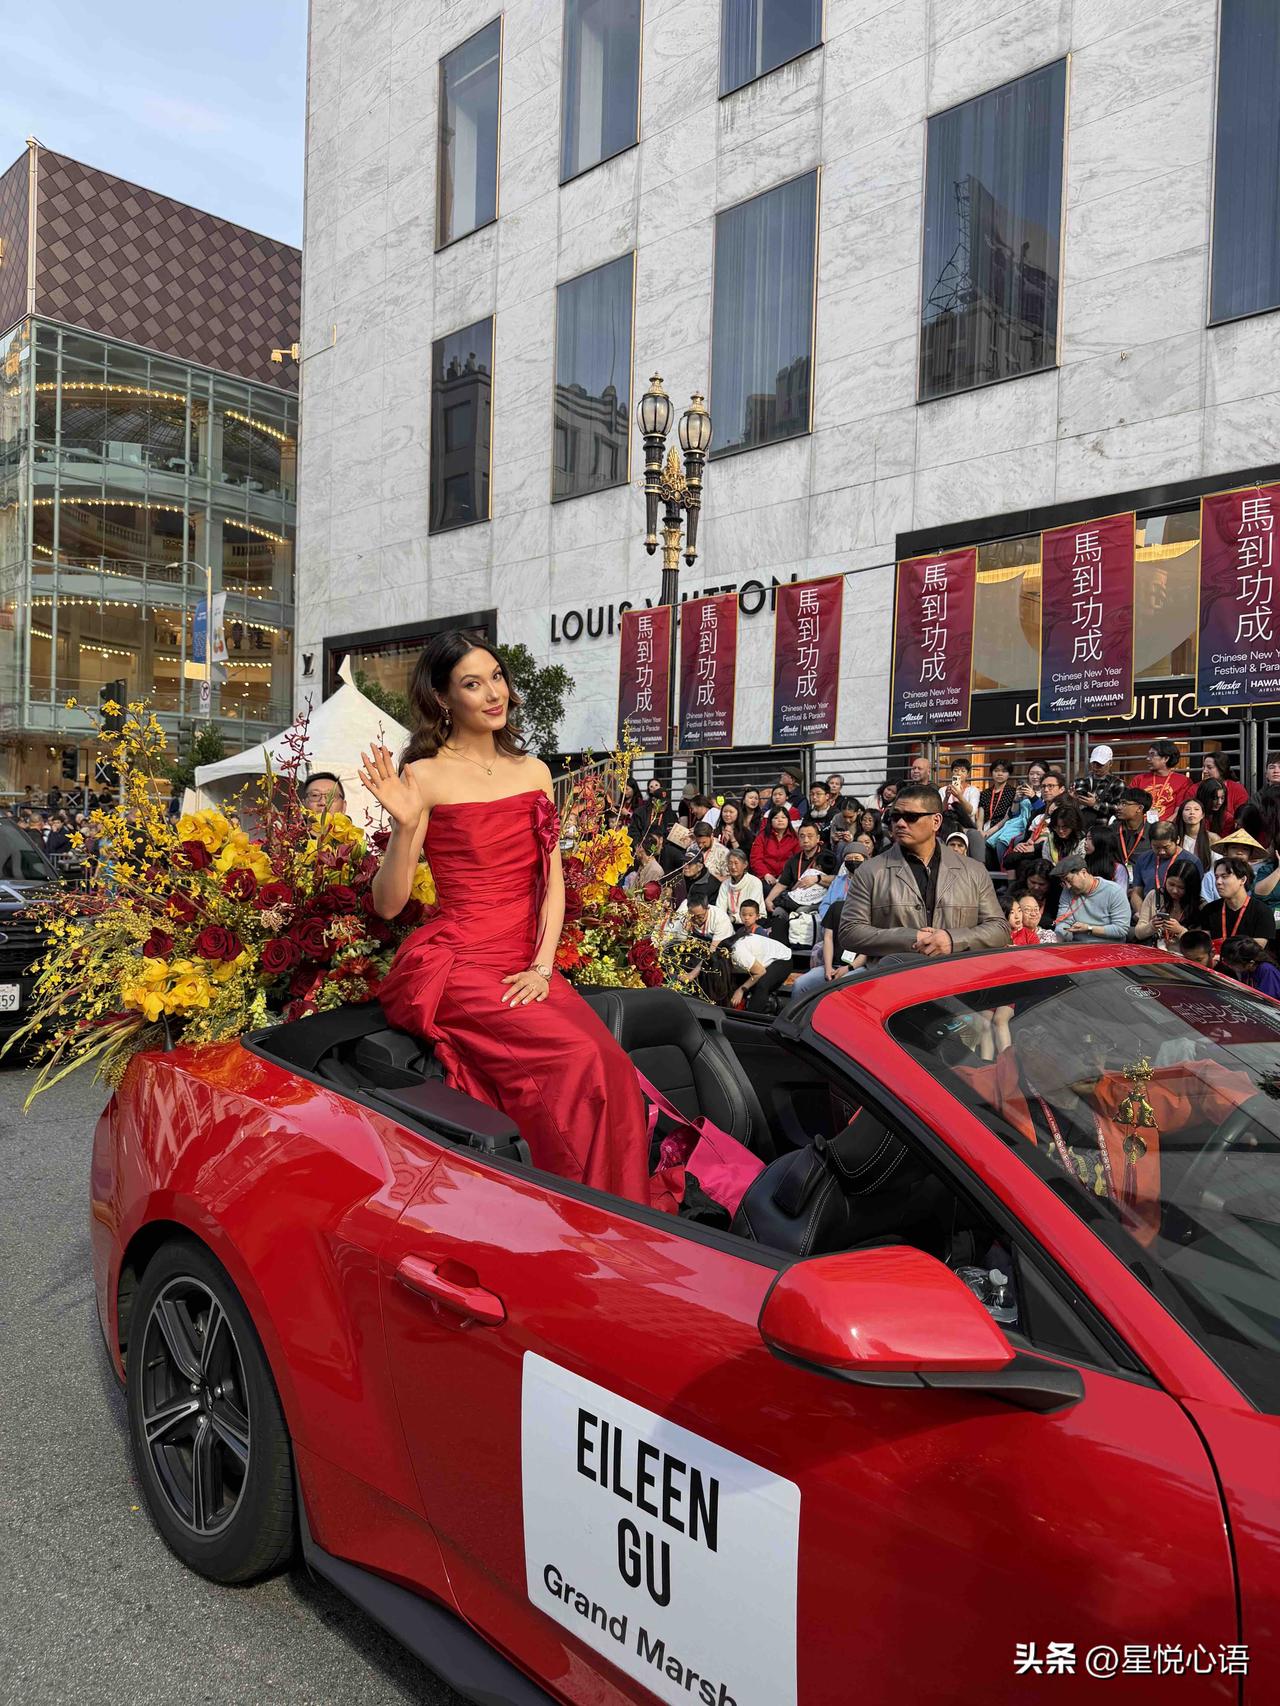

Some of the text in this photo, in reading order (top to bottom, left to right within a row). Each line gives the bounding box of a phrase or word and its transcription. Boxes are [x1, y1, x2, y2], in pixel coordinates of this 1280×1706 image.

[1234, 497, 1274, 643] 馬到功成
[1071, 530, 1103, 664] 馬到功成
[919, 562, 948, 683] 馬到功成
[795, 588, 819, 698] 馬到功成
[696, 603, 718, 706] 馬到功成
[1212, 653, 1248, 664] Chinese
[1251, 651, 1273, 660] New
[635, 615, 653, 712] 馬到功成
[1215, 665, 1247, 676] Festival
[1250, 664, 1257, 673] &
[1052, 667, 1123, 683] Chinese New Year
[903, 687, 961, 699] Chinese New Year
[1055, 679, 1120, 693] Festival & Parade
[1210, 681, 1242, 691] Alaska
[818, 702, 829, 710] Year
[905, 701, 927, 709] Festival
[936, 698, 958, 706] Parade
[1051, 694, 1124, 708] Alaska HAWAIIAN
[783, 714, 802, 722] Festival
[809, 712, 826, 720] Parade
[902, 711, 962, 722] Alaska HAWAIIAN
[0, 994, 16, 1008] 59
[576, 1407, 719, 1553] EILEEN
[617, 1517, 671, 1607] GU
[542, 1563, 628, 1644] Grand
